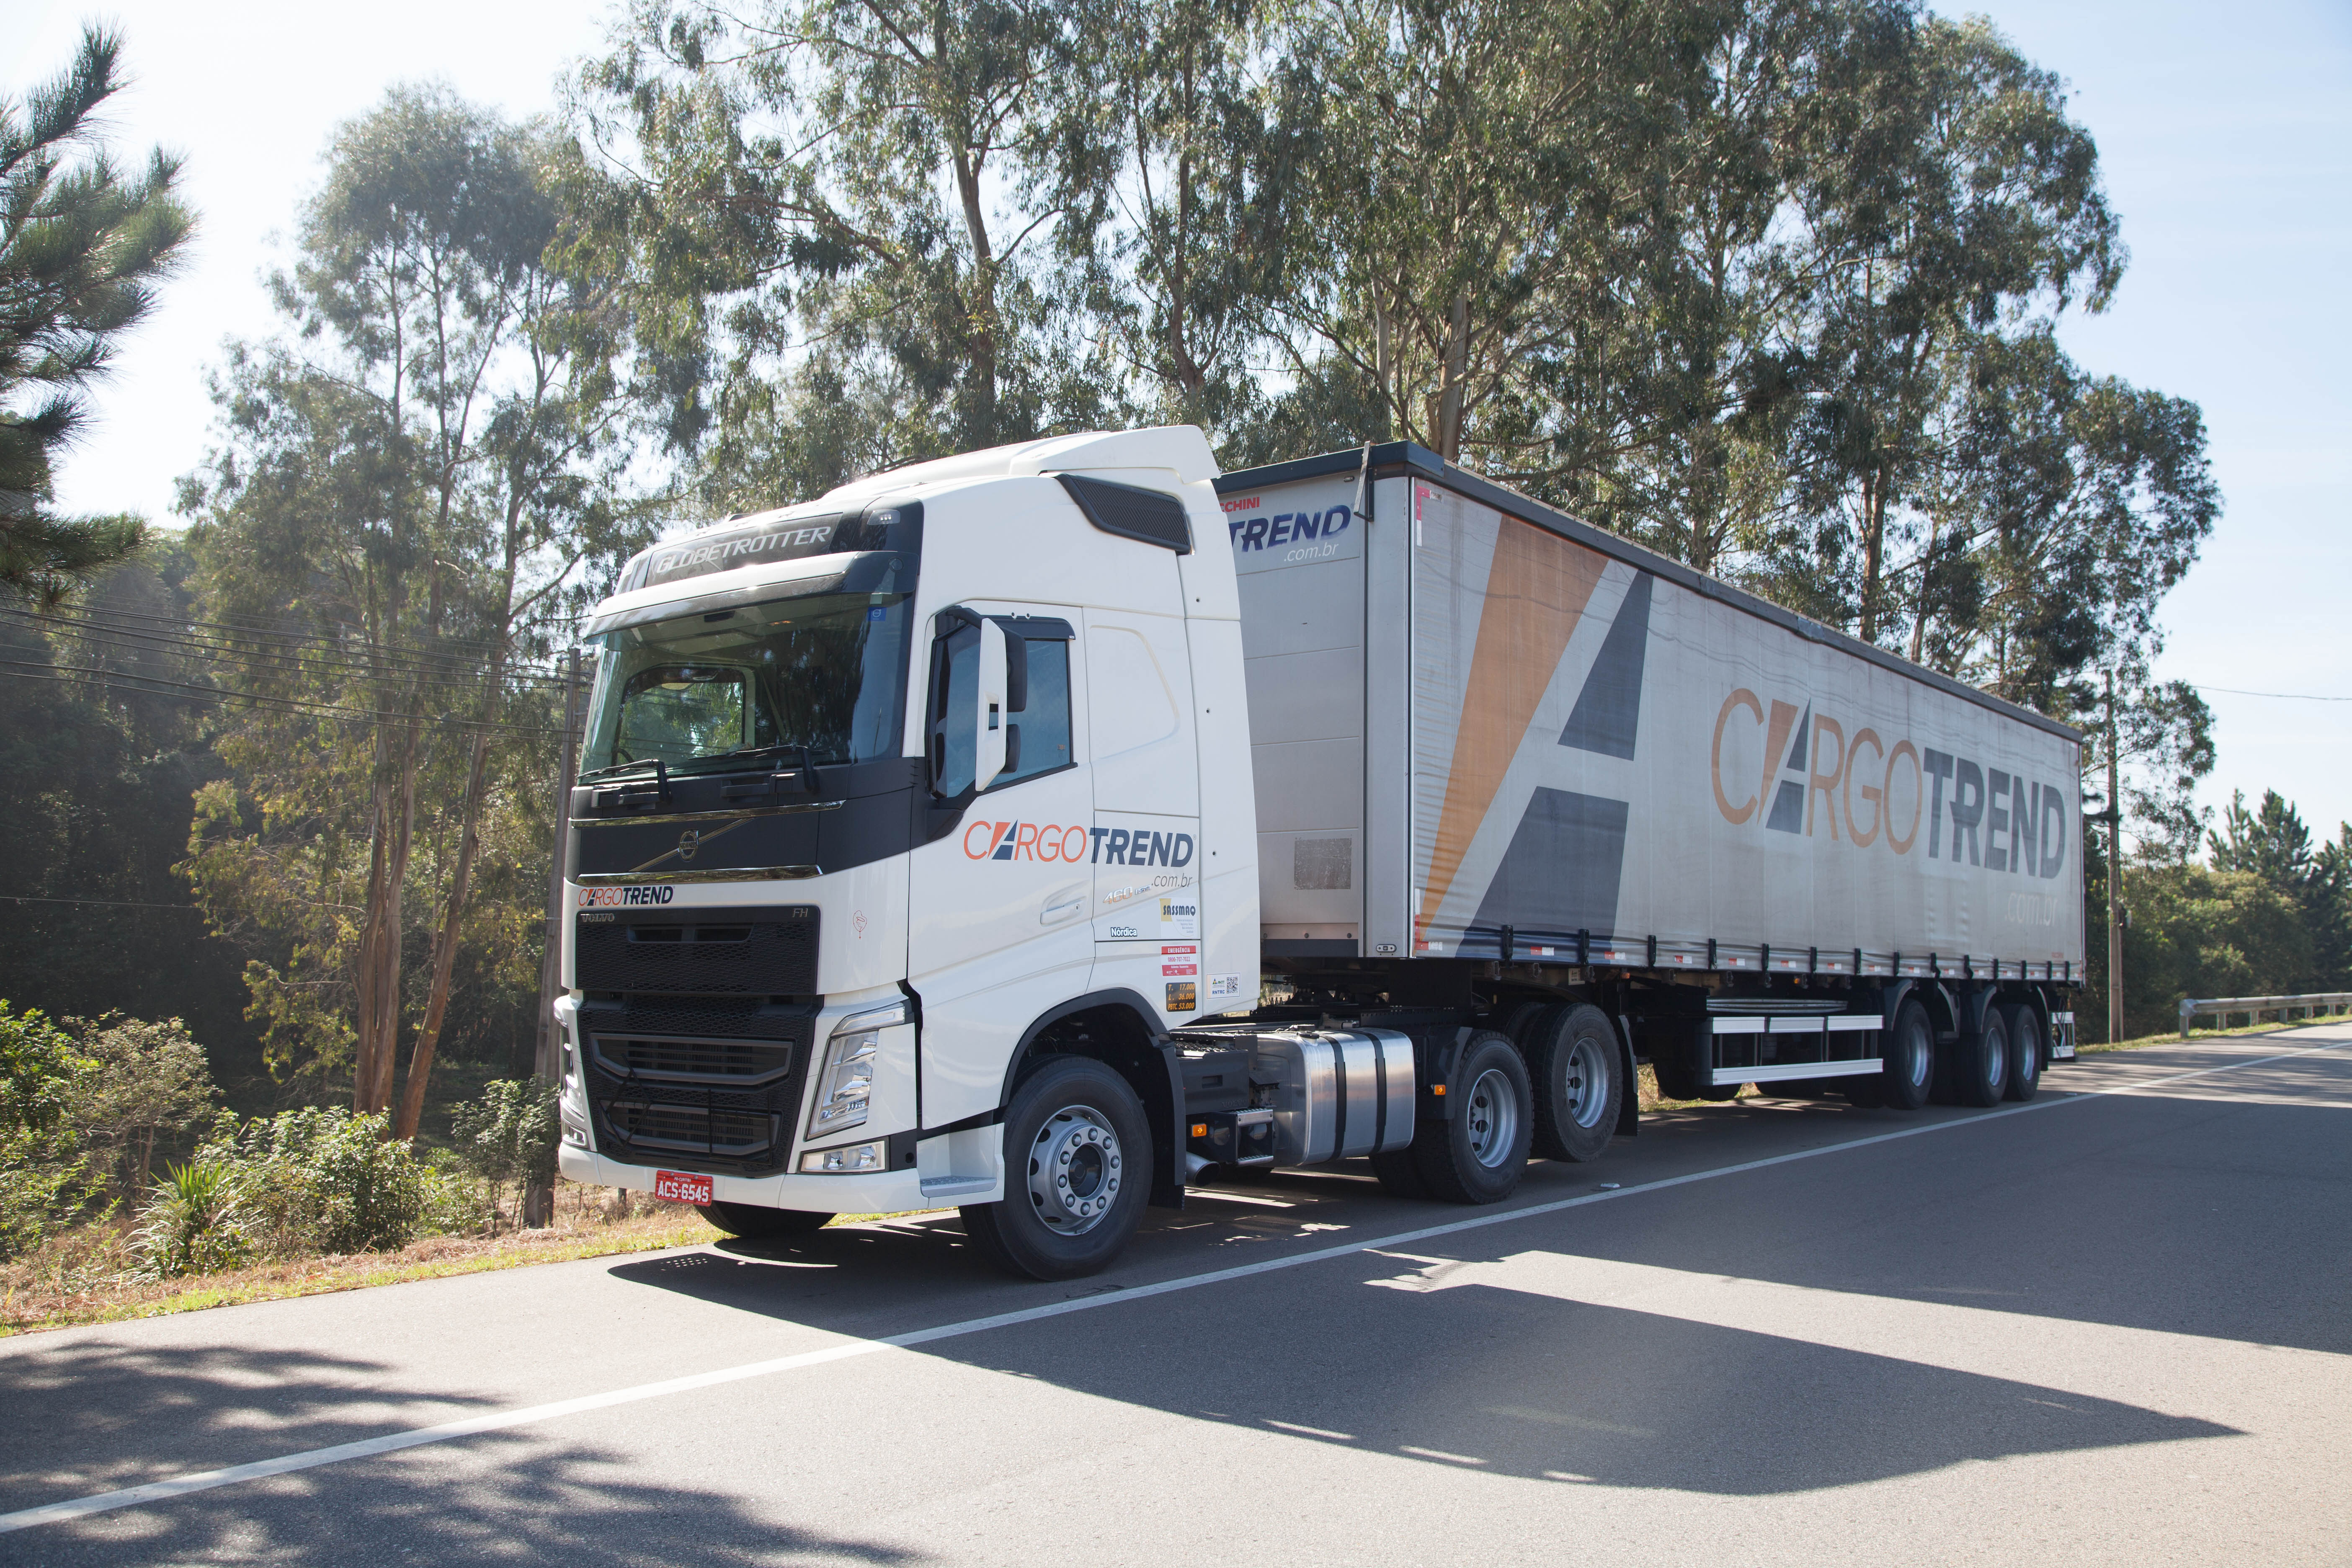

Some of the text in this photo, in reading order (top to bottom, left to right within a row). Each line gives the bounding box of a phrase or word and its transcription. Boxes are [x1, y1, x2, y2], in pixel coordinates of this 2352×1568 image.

[1229, 505, 1351, 552] TREND
[657, 526, 830, 573] GLOBETROTTER
[1284, 542, 1339, 562] .com.br
[1712, 688, 2066, 879] CARGOTREND
[964, 820, 1193, 867] CARGOTREND
[1151, 873, 1192, 887] .com.br
[578, 886, 673, 906] CARGOTREND
[1103, 886, 1132, 904] 460
[580, 913, 615, 922] VOLVO
[792, 908, 808, 917] FH
[1163, 905, 1196, 916] SASSMAQ
[1111, 927, 1137, 937] Nórdica
